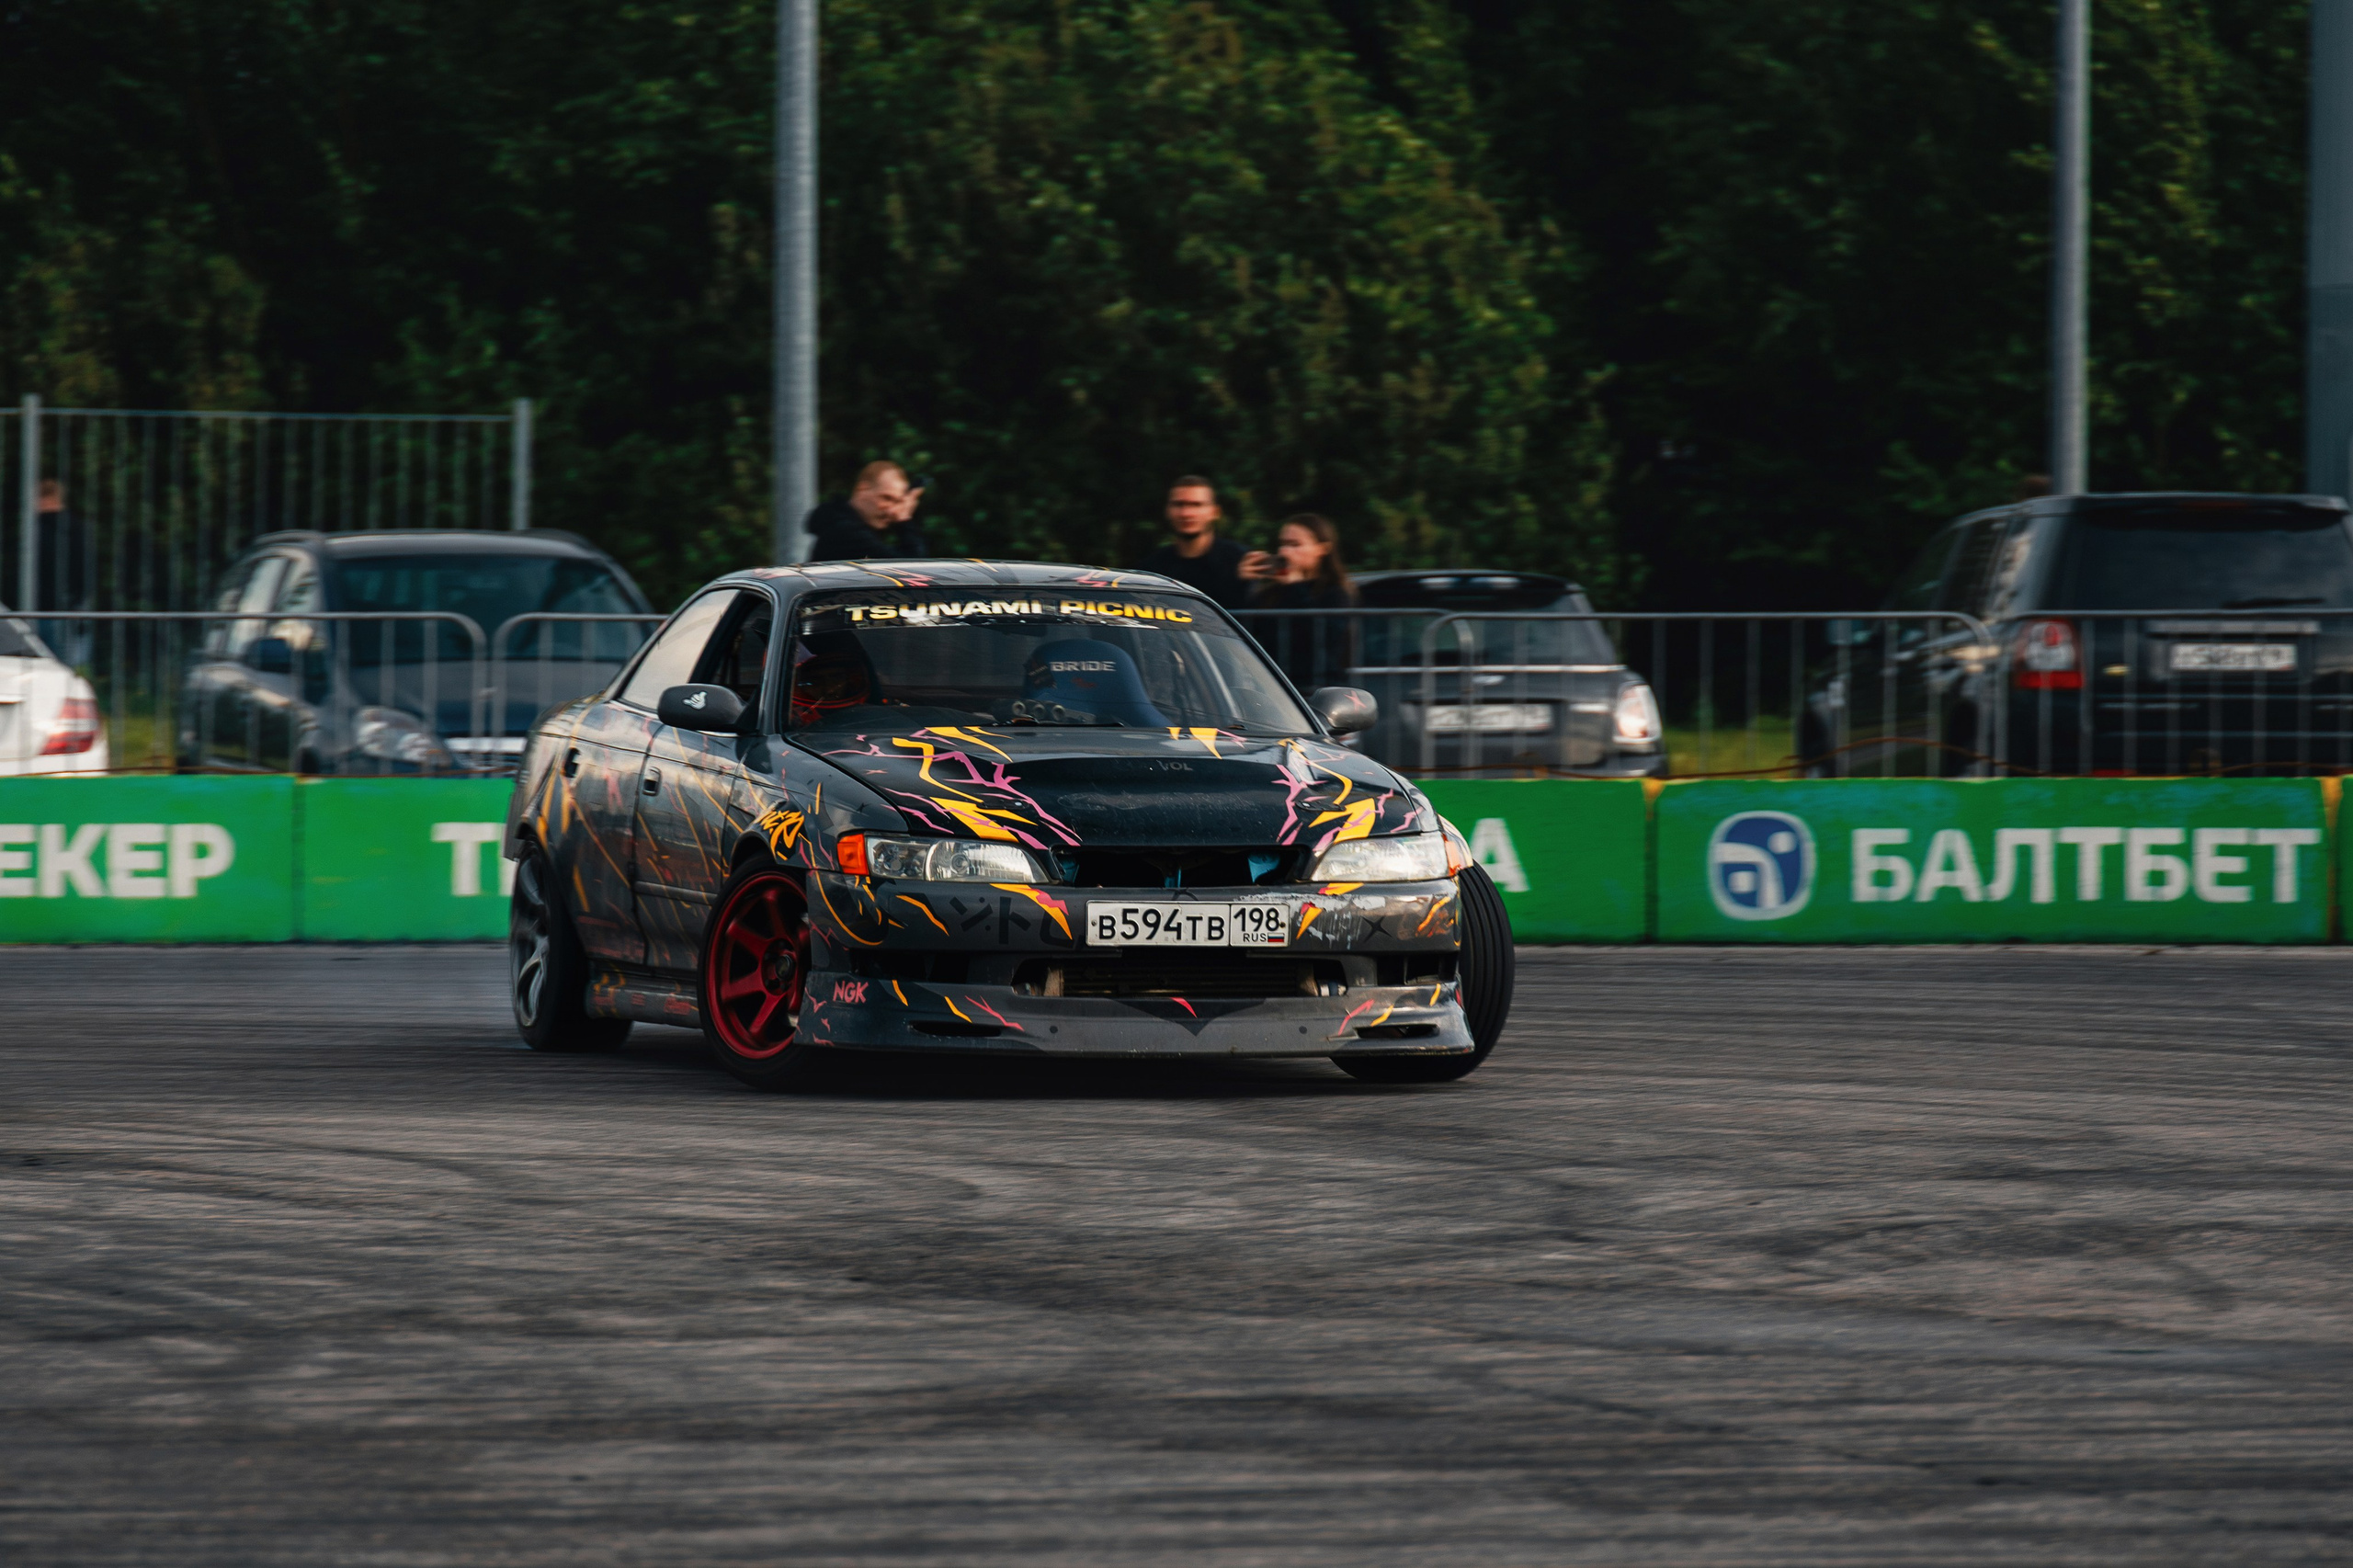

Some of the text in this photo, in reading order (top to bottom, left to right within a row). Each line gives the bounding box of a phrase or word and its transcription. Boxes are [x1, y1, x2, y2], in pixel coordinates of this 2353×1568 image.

[846, 598, 1194, 624] TSUNAMI PICNIC
[1050, 661, 1117, 672] BRIDE
[1850, 827, 2323, 903] БАЛТБЕТ
[1098, 908, 1225, 940] В594ТВ
[1233, 907, 1280, 932] 198
[1243, 932, 1267, 942] RUS
[833, 980, 870, 1004] NGK
